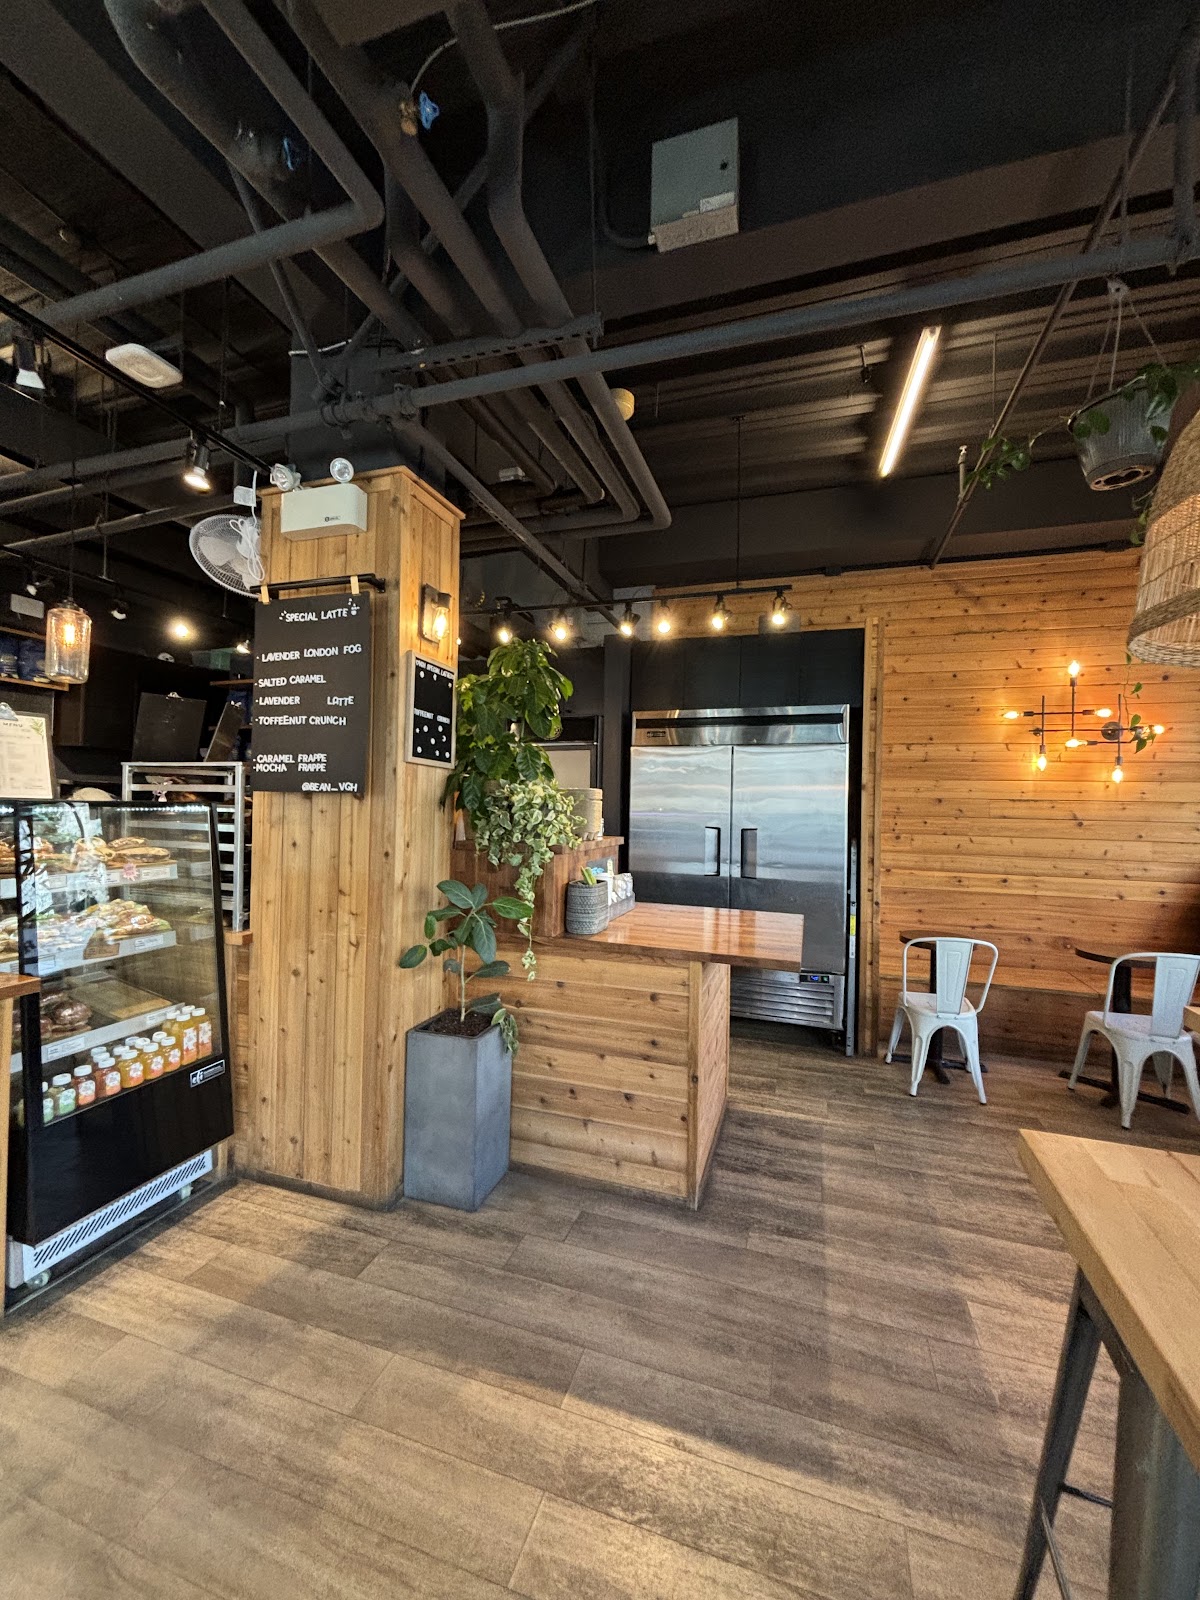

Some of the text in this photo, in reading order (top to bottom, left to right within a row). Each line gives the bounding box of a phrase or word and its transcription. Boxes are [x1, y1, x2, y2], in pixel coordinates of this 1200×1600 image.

[285, 608, 349, 622] SPECIAL LATTE
[261, 643, 362, 663] LAVENDER LONDON FOG
[258, 674, 327, 687] SALTED CARAMEL
[258, 696, 354, 706] LAVENDER LATTE
[258, 715, 346, 726] TOFFEENUT CRUNCH
[257, 753, 327, 763] CARAMEL FRAPPE
[255, 763, 326, 772] MOCHA FRAPPE
